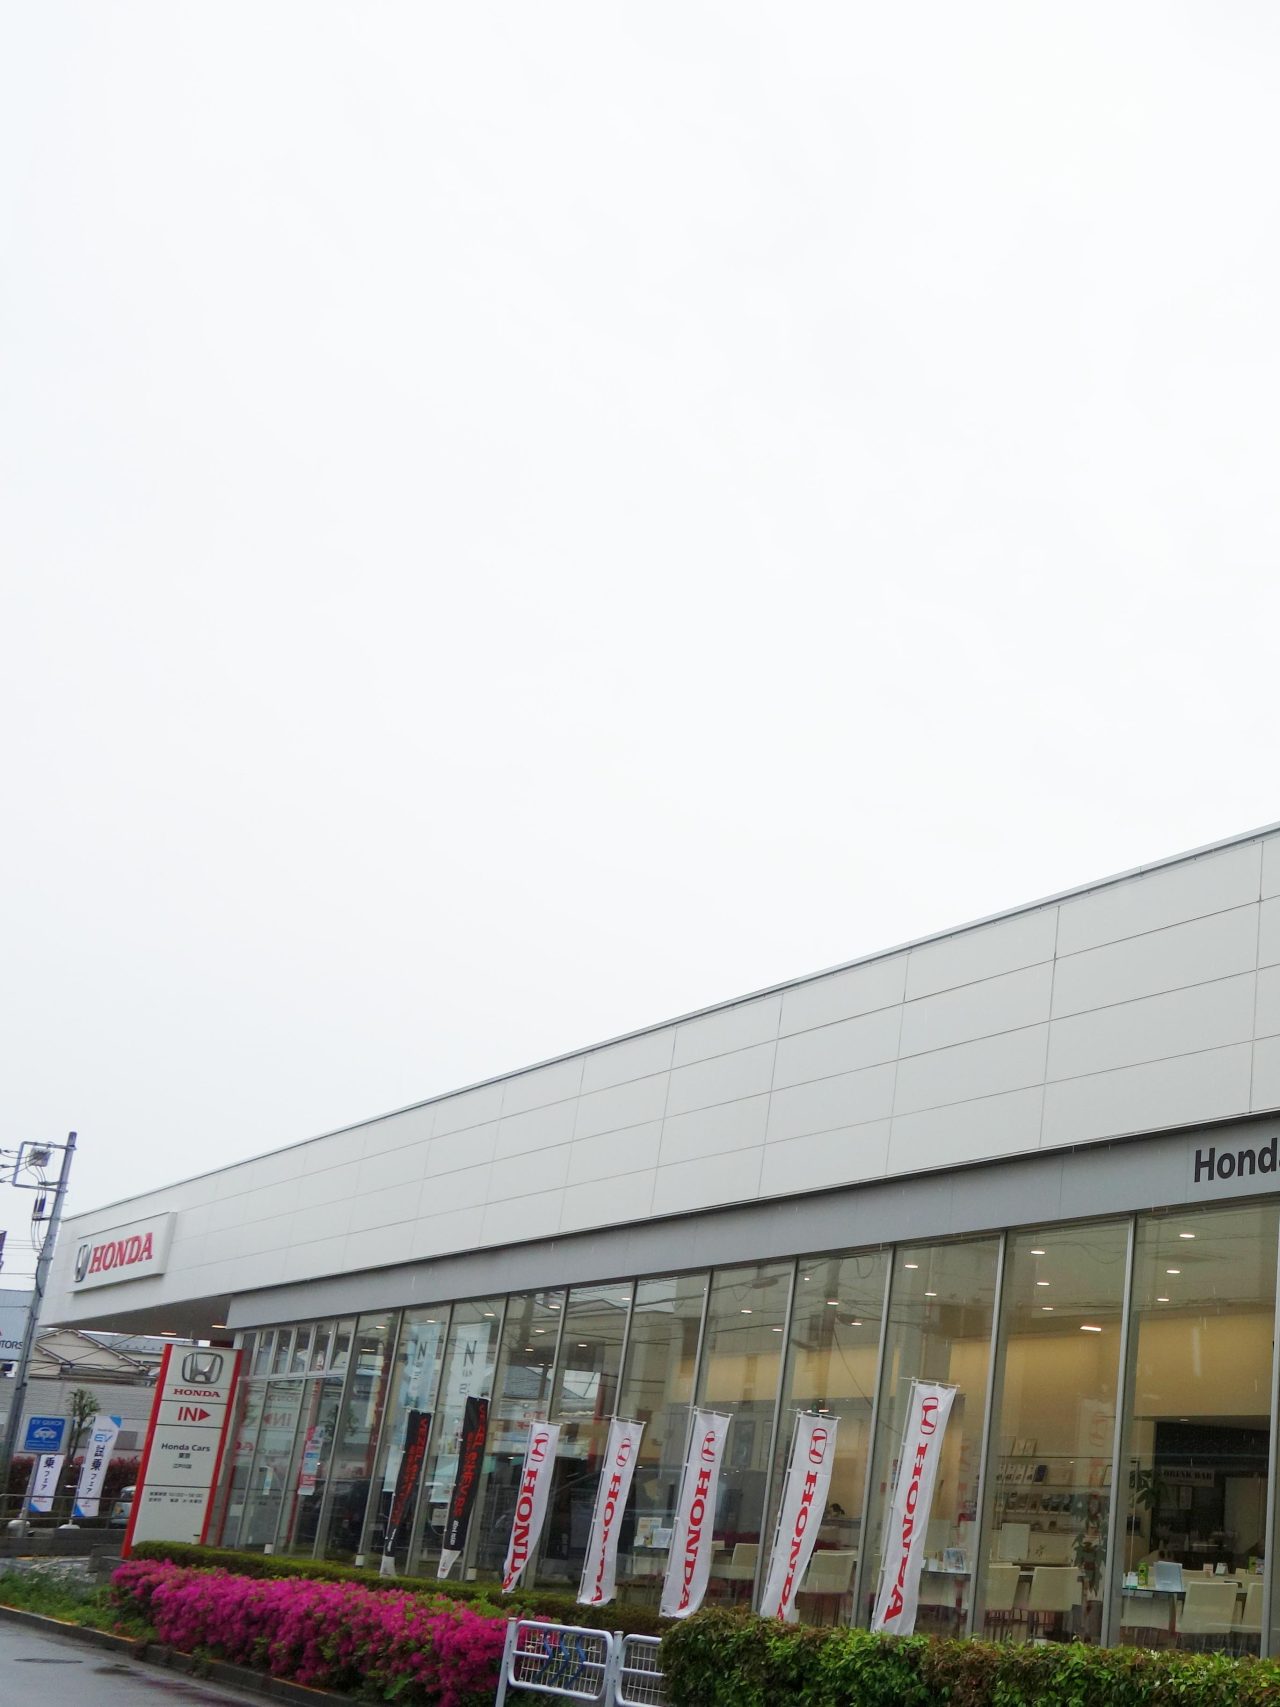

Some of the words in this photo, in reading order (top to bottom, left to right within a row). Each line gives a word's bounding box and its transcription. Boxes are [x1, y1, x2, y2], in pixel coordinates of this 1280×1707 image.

[88, 1232, 153, 1274] HONDA
[0, 1339, 24, 1350] TORS
[173, 1388, 221, 1398] HONDA
[177, 1406, 199, 1422] IN
[161, 1442, 190, 1451] Honda
[191, 1444, 211, 1452] Cars
[679, 1467, 712, 1610] HONDA
[884, 1442, 928, 1623] HONDA
